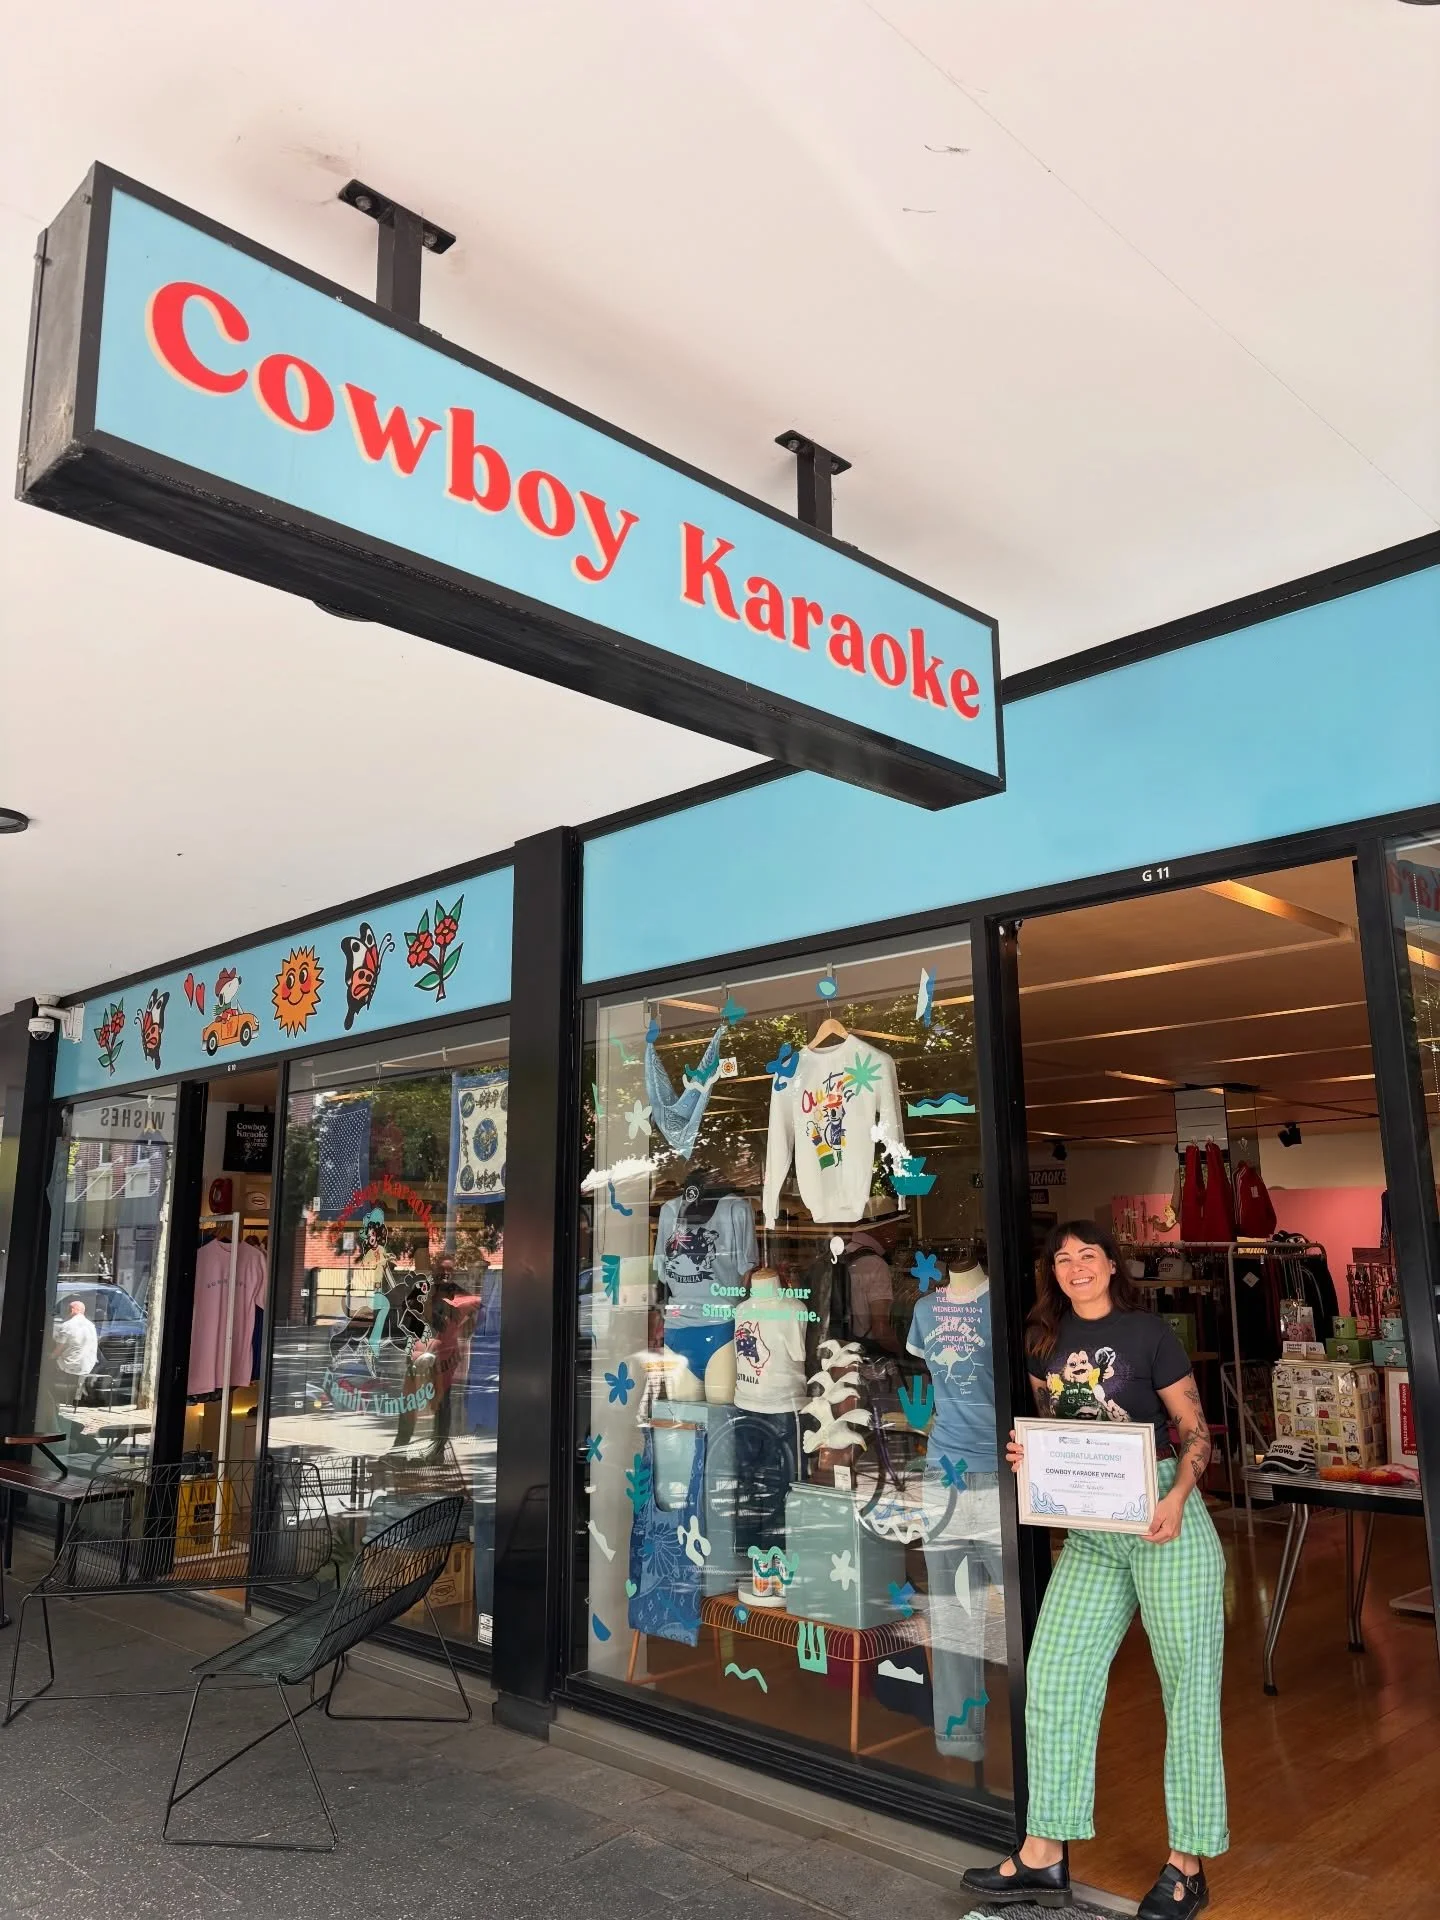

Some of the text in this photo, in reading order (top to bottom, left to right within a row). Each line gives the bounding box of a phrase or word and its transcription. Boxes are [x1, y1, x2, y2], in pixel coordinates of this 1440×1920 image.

[145, 282, 980, 721] Cowboy Karaoke
[1142, 866, 1169, 881] G 11
[236, 1122, 267, 1132] Cowboy
[236, 1129, 269, 1138] Karaoke
[710, 1282, 747, 1297] Come
[776, 1285, 811, 1300] your
[702, 1303, 738, 1320] Ships
[795, 1311, 821, 1323] me.
[932, 1305, 964, 1313] WEDNESDAY
[737, 1373, 759, 1384] STRALIA
[322, 1370, 436, 1417] Family Vintage
[1049, 1450, 1122, 1462] CONGRATULATIONS!
[1045, 1468, 1071, 1476] COWBOY
[1100, 1472, 1126, 1480] VINTAGE
